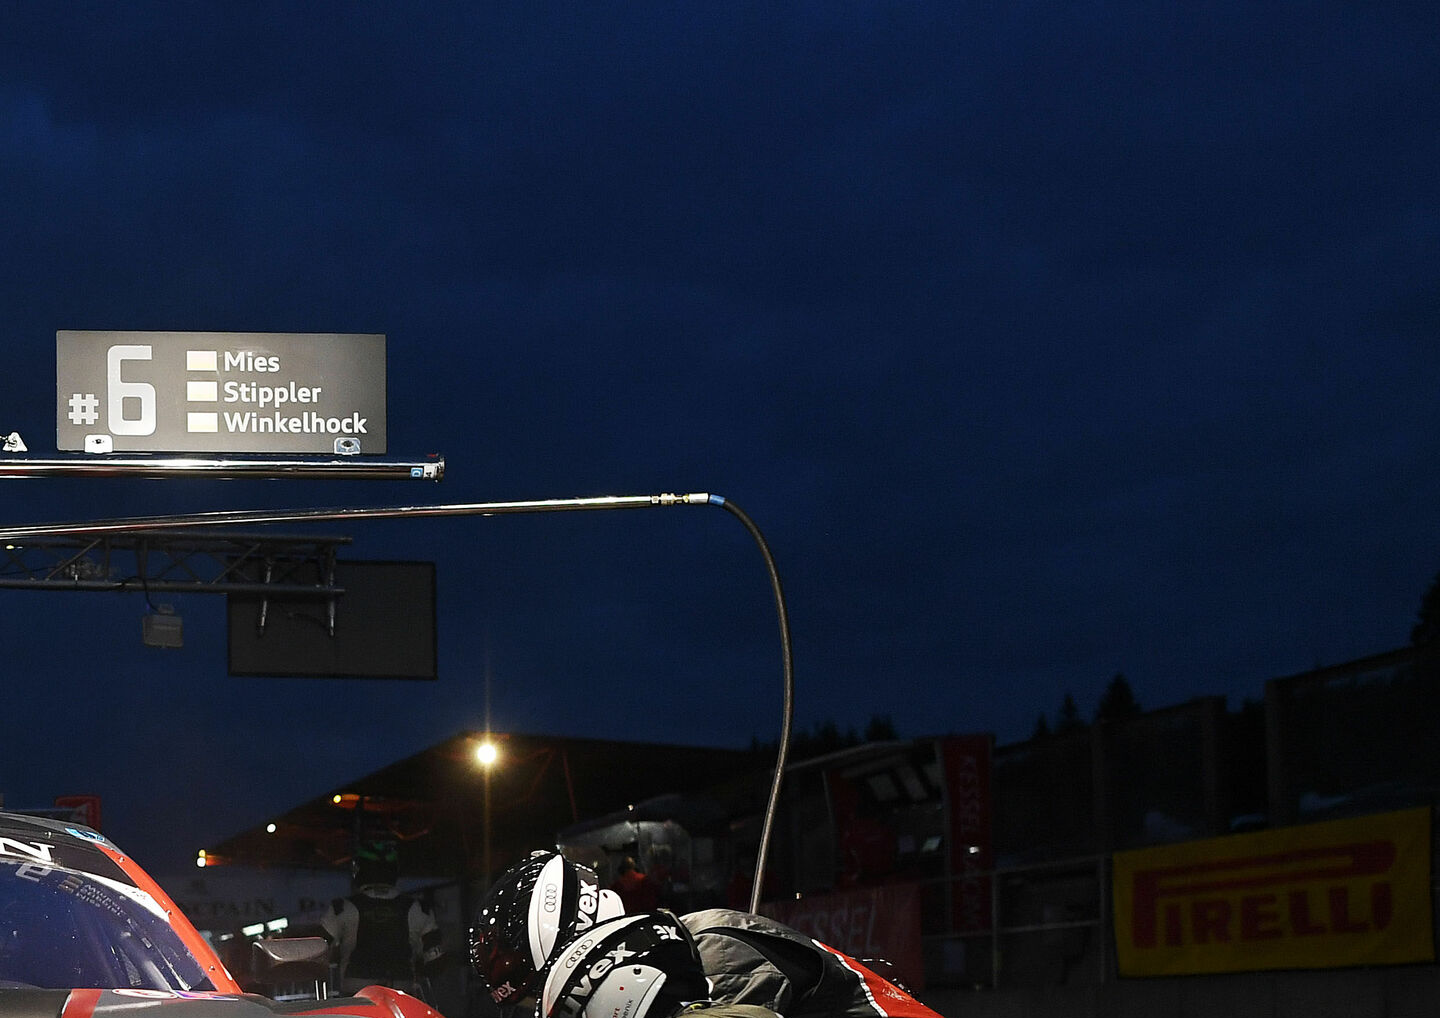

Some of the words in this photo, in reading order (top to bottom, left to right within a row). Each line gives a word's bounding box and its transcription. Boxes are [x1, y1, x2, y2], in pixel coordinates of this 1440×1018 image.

[224, 351, 280, 372] Mies
[224, 382, 322, 408] Stippler
[224, 412, 368, 434] Winkelhock
[1131, 840, 1397, 948] PIRELLI
